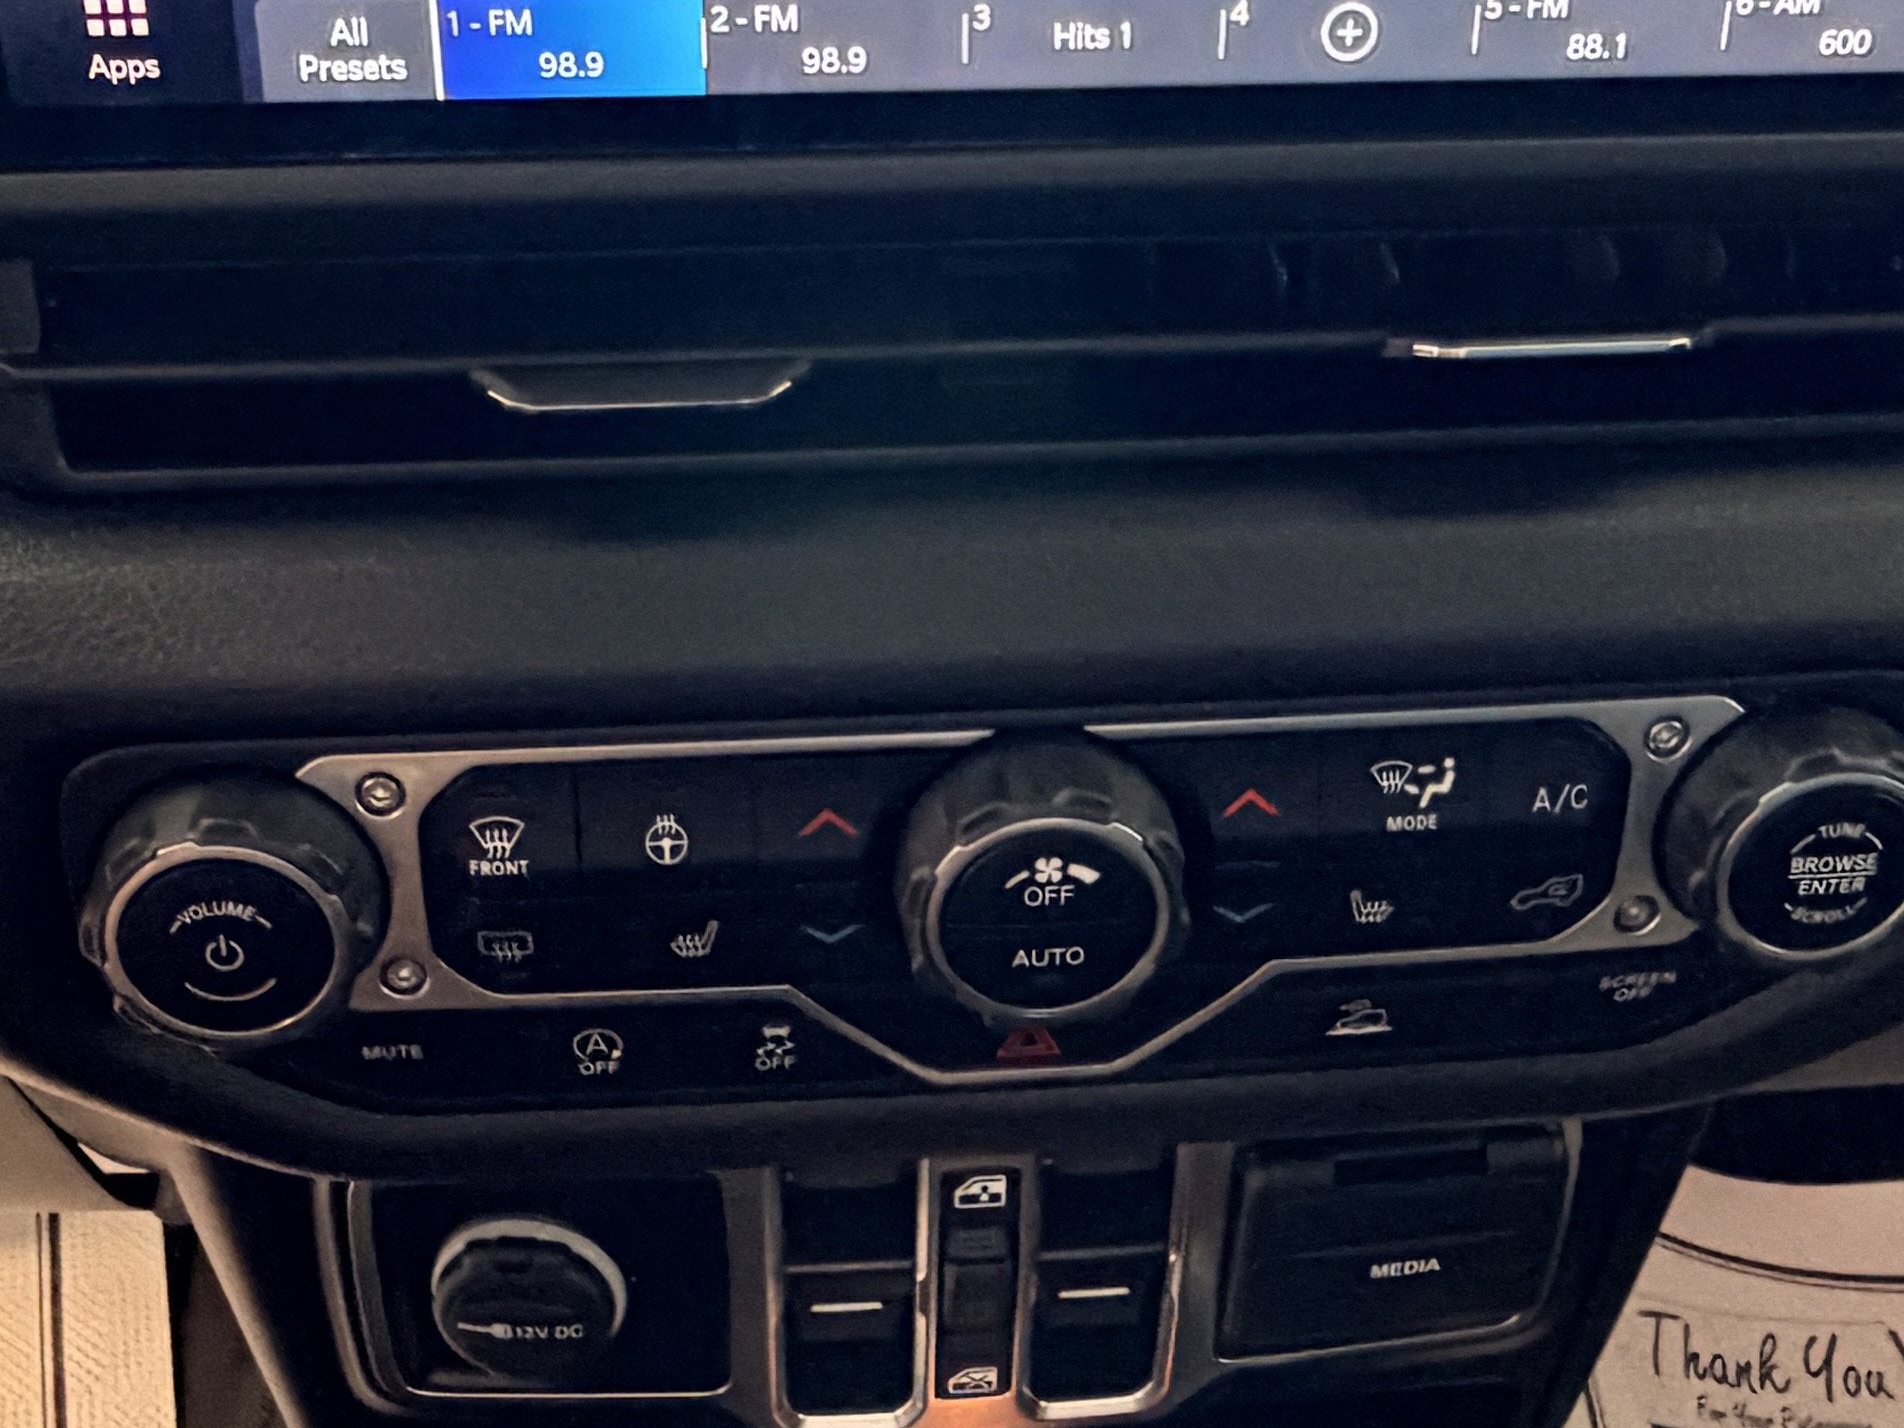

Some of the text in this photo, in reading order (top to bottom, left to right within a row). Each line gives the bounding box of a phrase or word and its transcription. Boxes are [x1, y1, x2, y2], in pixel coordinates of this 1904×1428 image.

[446, 11, 459, 37] 1
[489, 9, 533, 38] FM
[709, 5, 730, 33] 2
[753, 5, 799, 33] FM
[972, 3, 991, 31] 3
[1229, 0, 1250, 27] 4
[329, 16, 368, 47] All
[1053, 21, 1132, 51] Hits 1
[1818, 28, 1872, 56] 600
[1566, 32, 1627, 60] 88.1
[89, 54, 161, 85] Apps
[299, 54, 408, 84] Presets
[537, 50, 606, 80] 98.9
[801, 46, 868, 75] 98.9
[1532, 785, 1589, 812] A/C
[1386, 815, 1438, 832] MODE
[1818, 822, 1866, 839] TUNE
[469, 860, 529, 877] FRONT
[1790, 852, 1878, 874] BROWSE
[1023, 886, 1075, 907] OFF
[1798, 877, 1866, 895] ENTER
[176, 901, 257, 925] VOLUME
[1011, 947, 1085, 968] AUTO
[578, 1062, 620, 1076] OFF
[754, 1057, 795, 1071] OFF
[1370, 1258, 1441, 1280] MEDIA
[1638, 1309, 1896, 1403] Thank You
